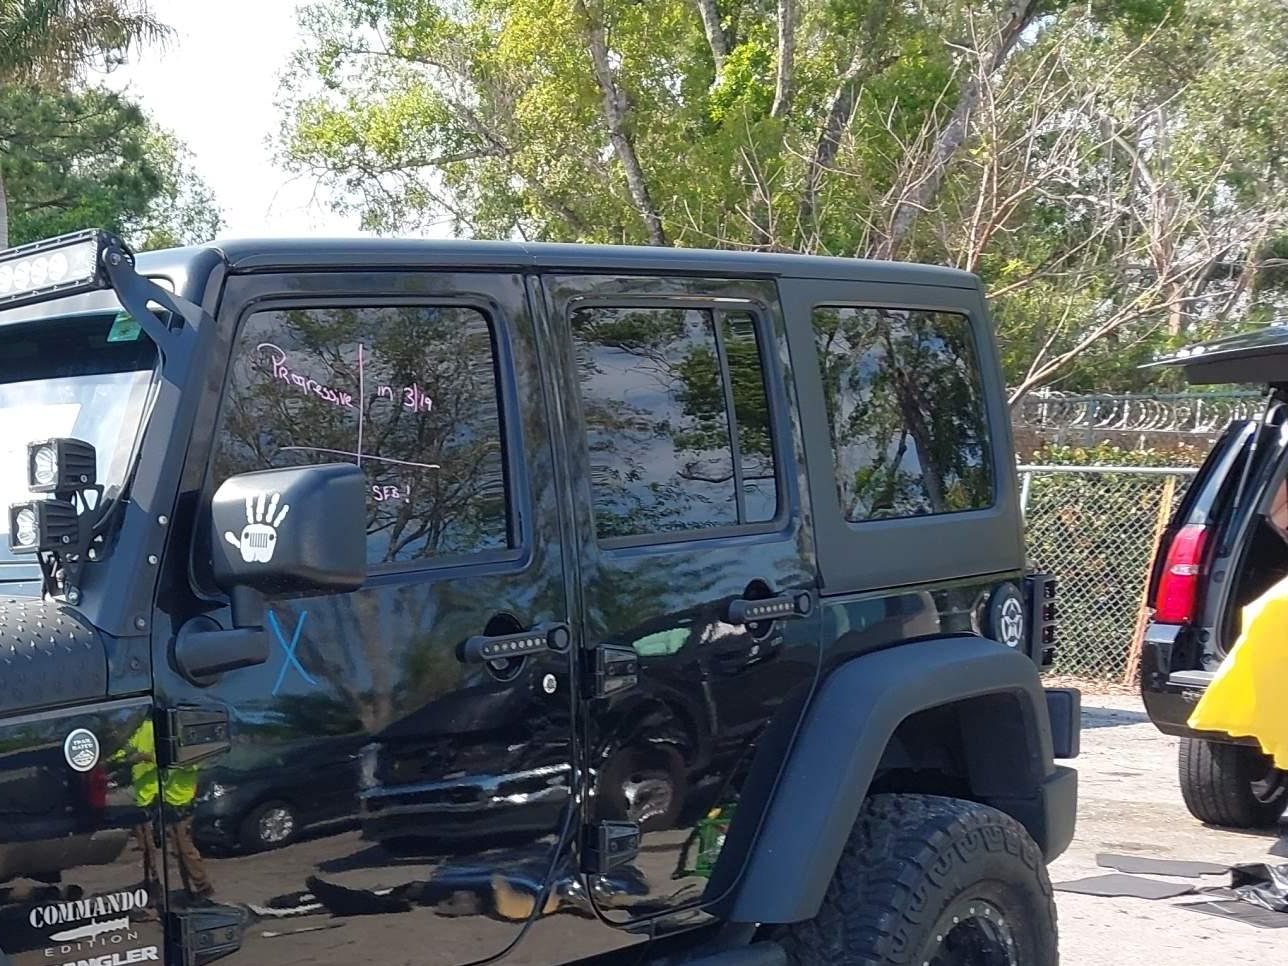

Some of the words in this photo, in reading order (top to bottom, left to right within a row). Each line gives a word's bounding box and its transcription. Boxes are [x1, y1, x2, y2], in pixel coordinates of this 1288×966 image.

[377, 385, 393, 401] in
[403, 382, 432, 412] 3/19
[29, 888, 149, 928] COMMANDO
[44, 930, 138, 957] EDITION
